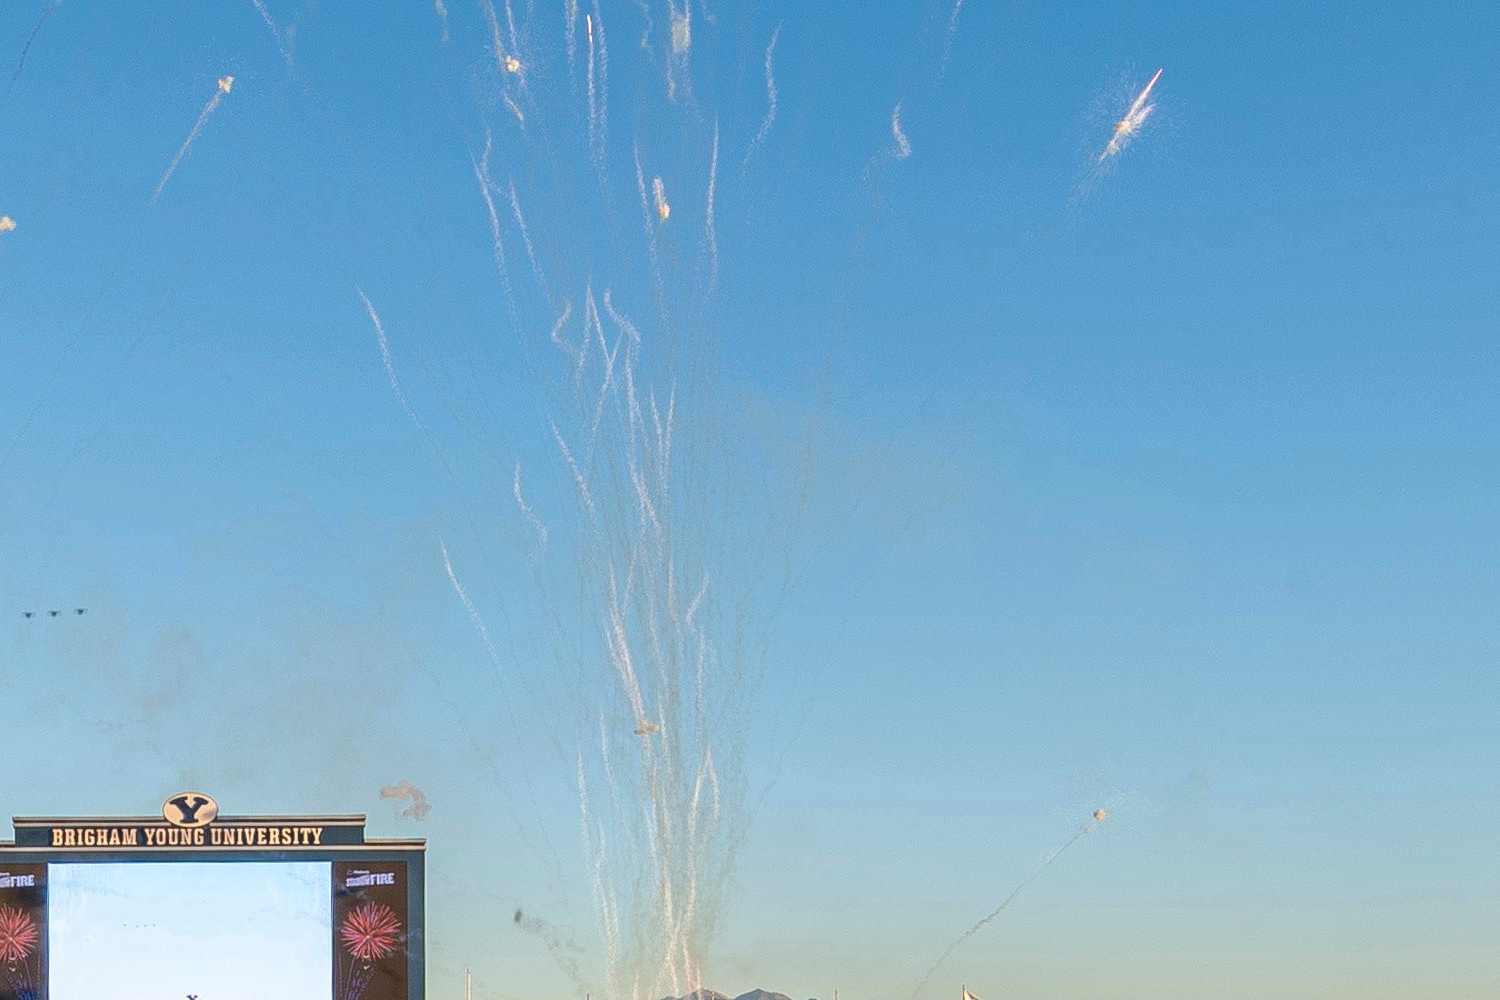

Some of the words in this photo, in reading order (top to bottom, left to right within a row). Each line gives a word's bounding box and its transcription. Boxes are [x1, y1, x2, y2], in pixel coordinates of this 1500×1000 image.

[169, 795, 209, 824] Y
[52, 828, 137, 847] BRIGHAM
[144, 828, 204, 846] YOUNG
[211, 827, 323, 845] UNIVERSITY
[10, 875, 35, 887] FIRE
[370, 873, 395, 885] FIRE
